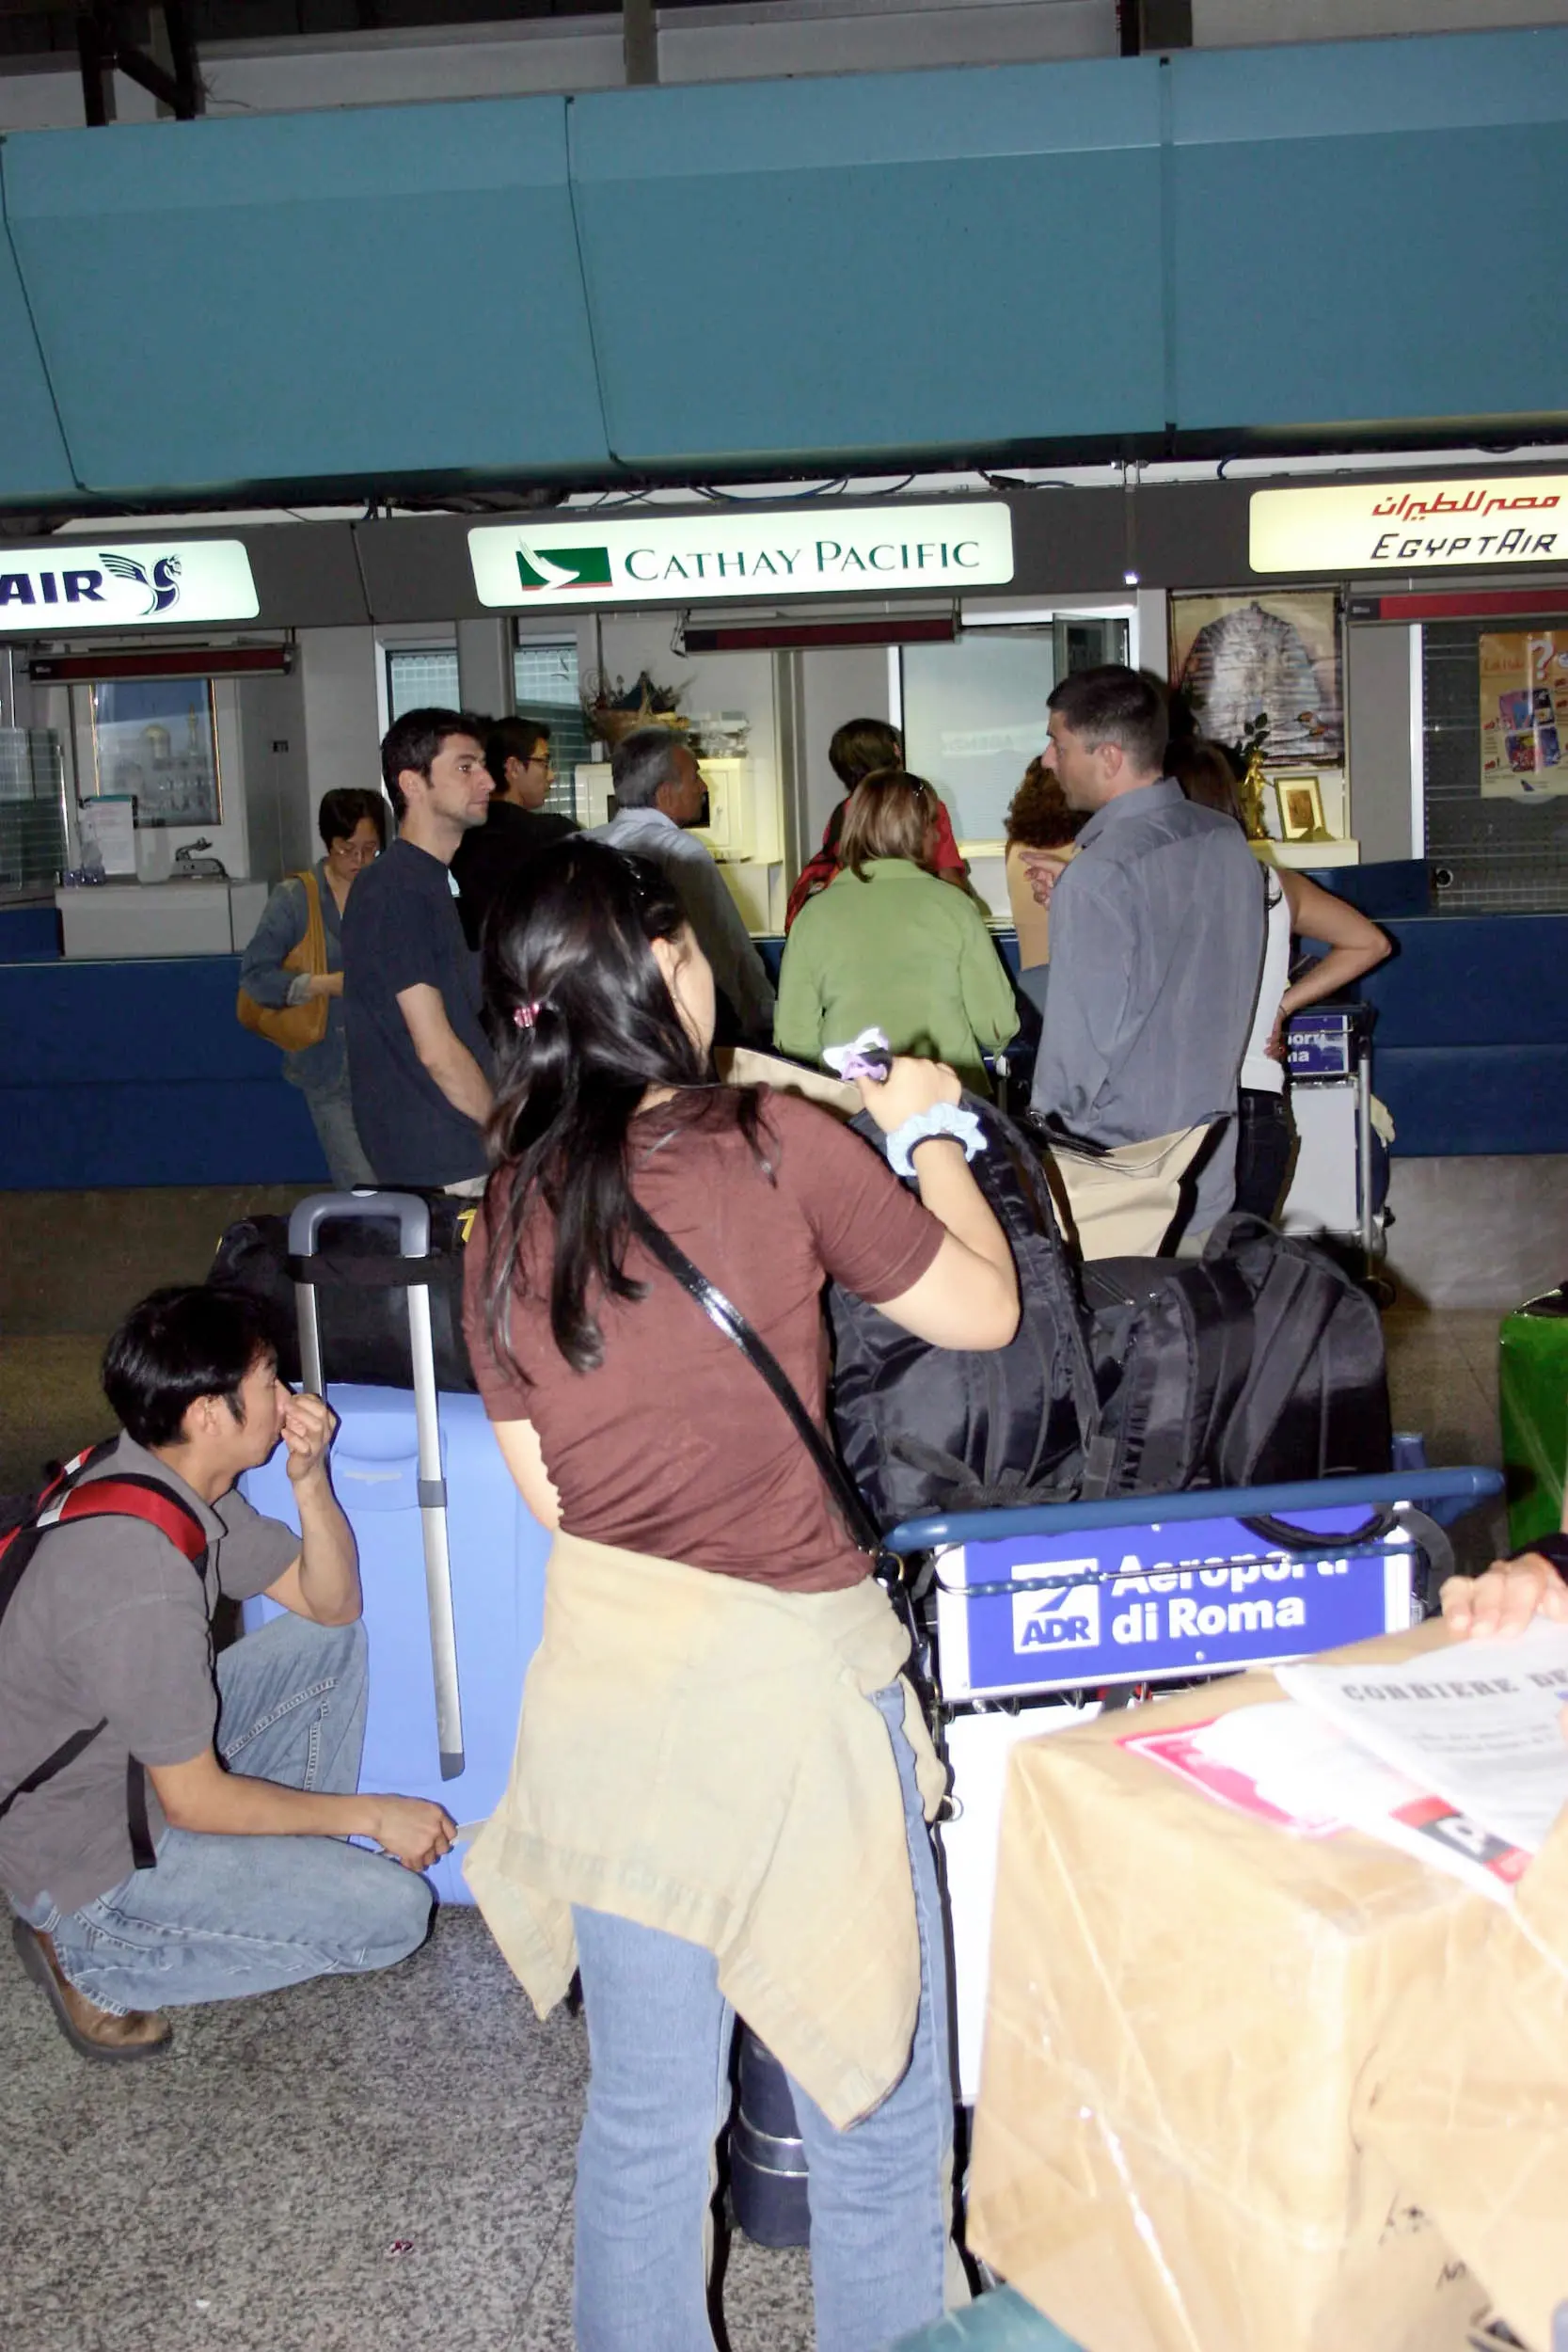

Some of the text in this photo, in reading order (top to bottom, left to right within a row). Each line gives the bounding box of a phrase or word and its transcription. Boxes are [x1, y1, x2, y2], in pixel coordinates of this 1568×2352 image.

[624, 541, 980, 581] CATHAY PACIFIC
[0, 570, 107, 605] AIR
[1020, 1615, 1092, 1646] ADR
[1112, 1597, 1307, 1645] di Roma
